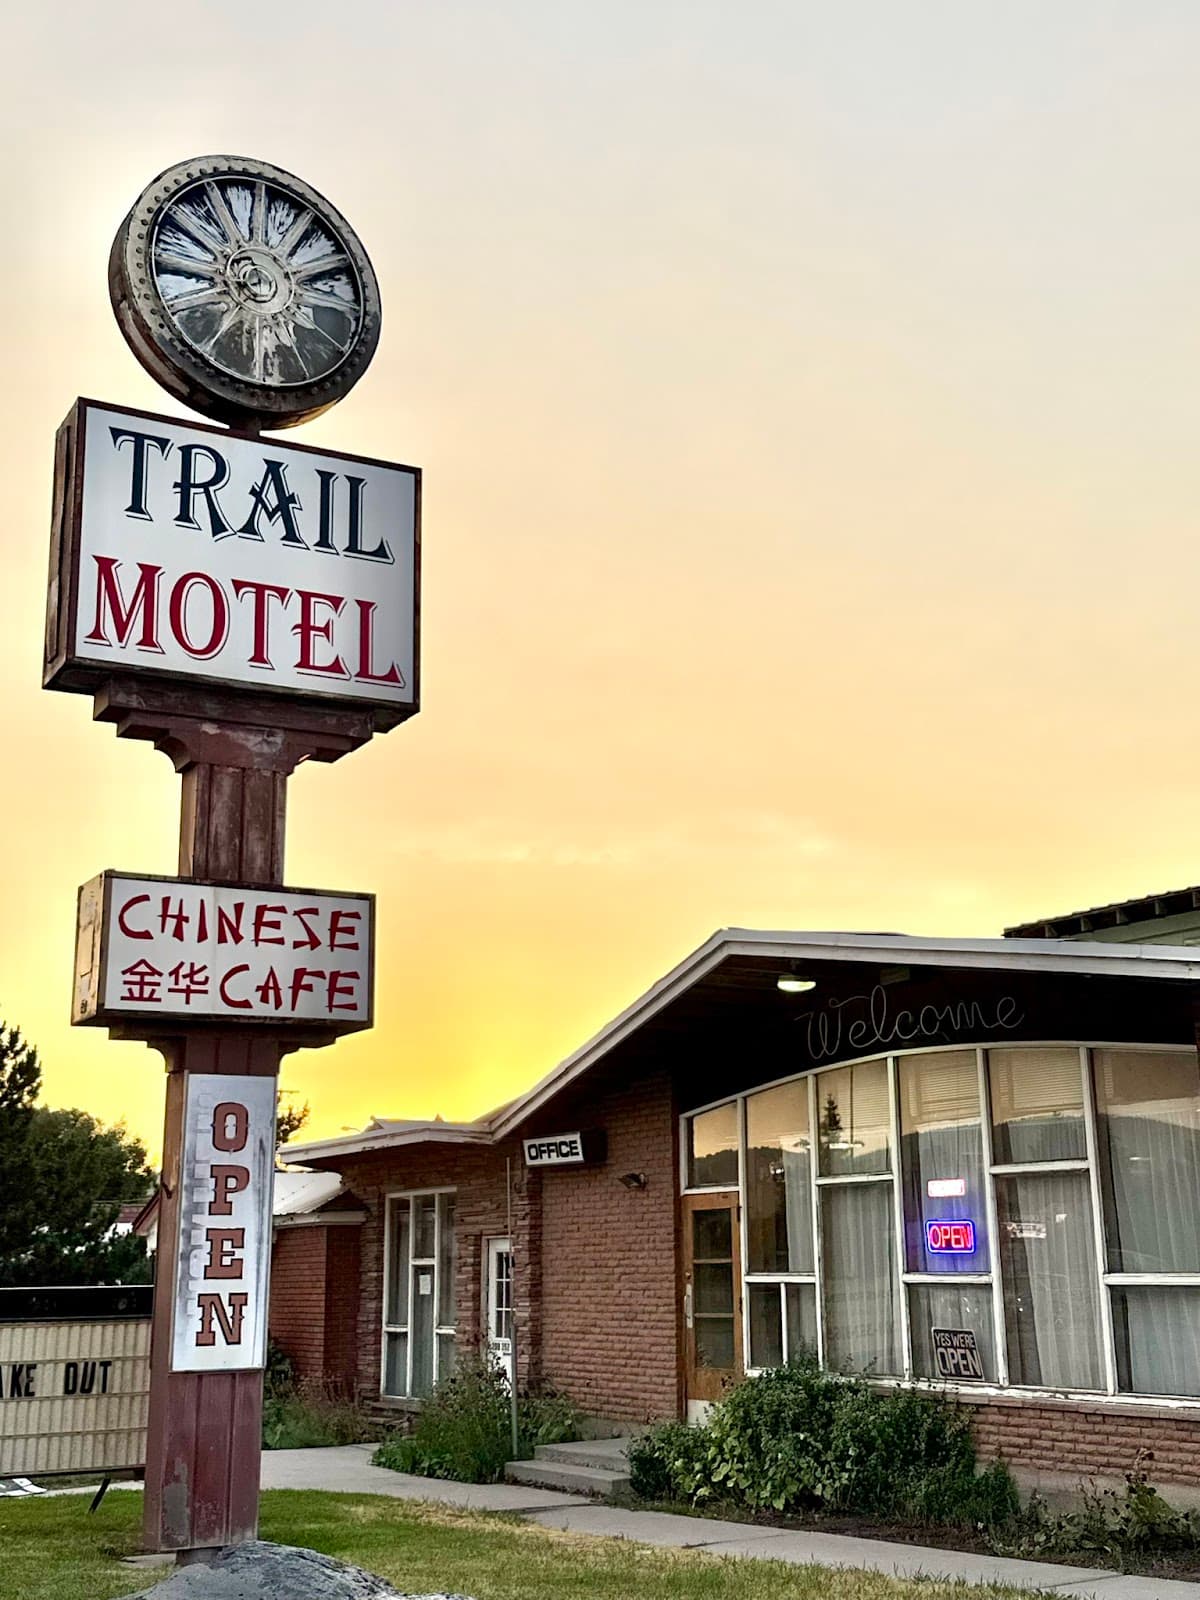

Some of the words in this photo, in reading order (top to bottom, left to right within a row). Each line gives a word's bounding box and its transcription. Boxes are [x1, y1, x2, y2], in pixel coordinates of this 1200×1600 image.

[109, 426, 395, 564] TRAIL
[83, 554, 406, 689] MOTEL
[118, 894, 362, 952] CHINESE
[119, 958, 209, 1005] 金华
[219, 963, 361, 1013] CAFE
[794, 985, 1025, 1059] Welcome
[527, 1140, 580, 1161] OFFICE
[195, 1101, 250, 1347] OPEN
[929, 1224, 973, 1249] OPEN
[934, 1332, 951, 1347] YES
[936, 1347, 982, 1377] OPEN
[63, 1360, 113, 1395] OUT
